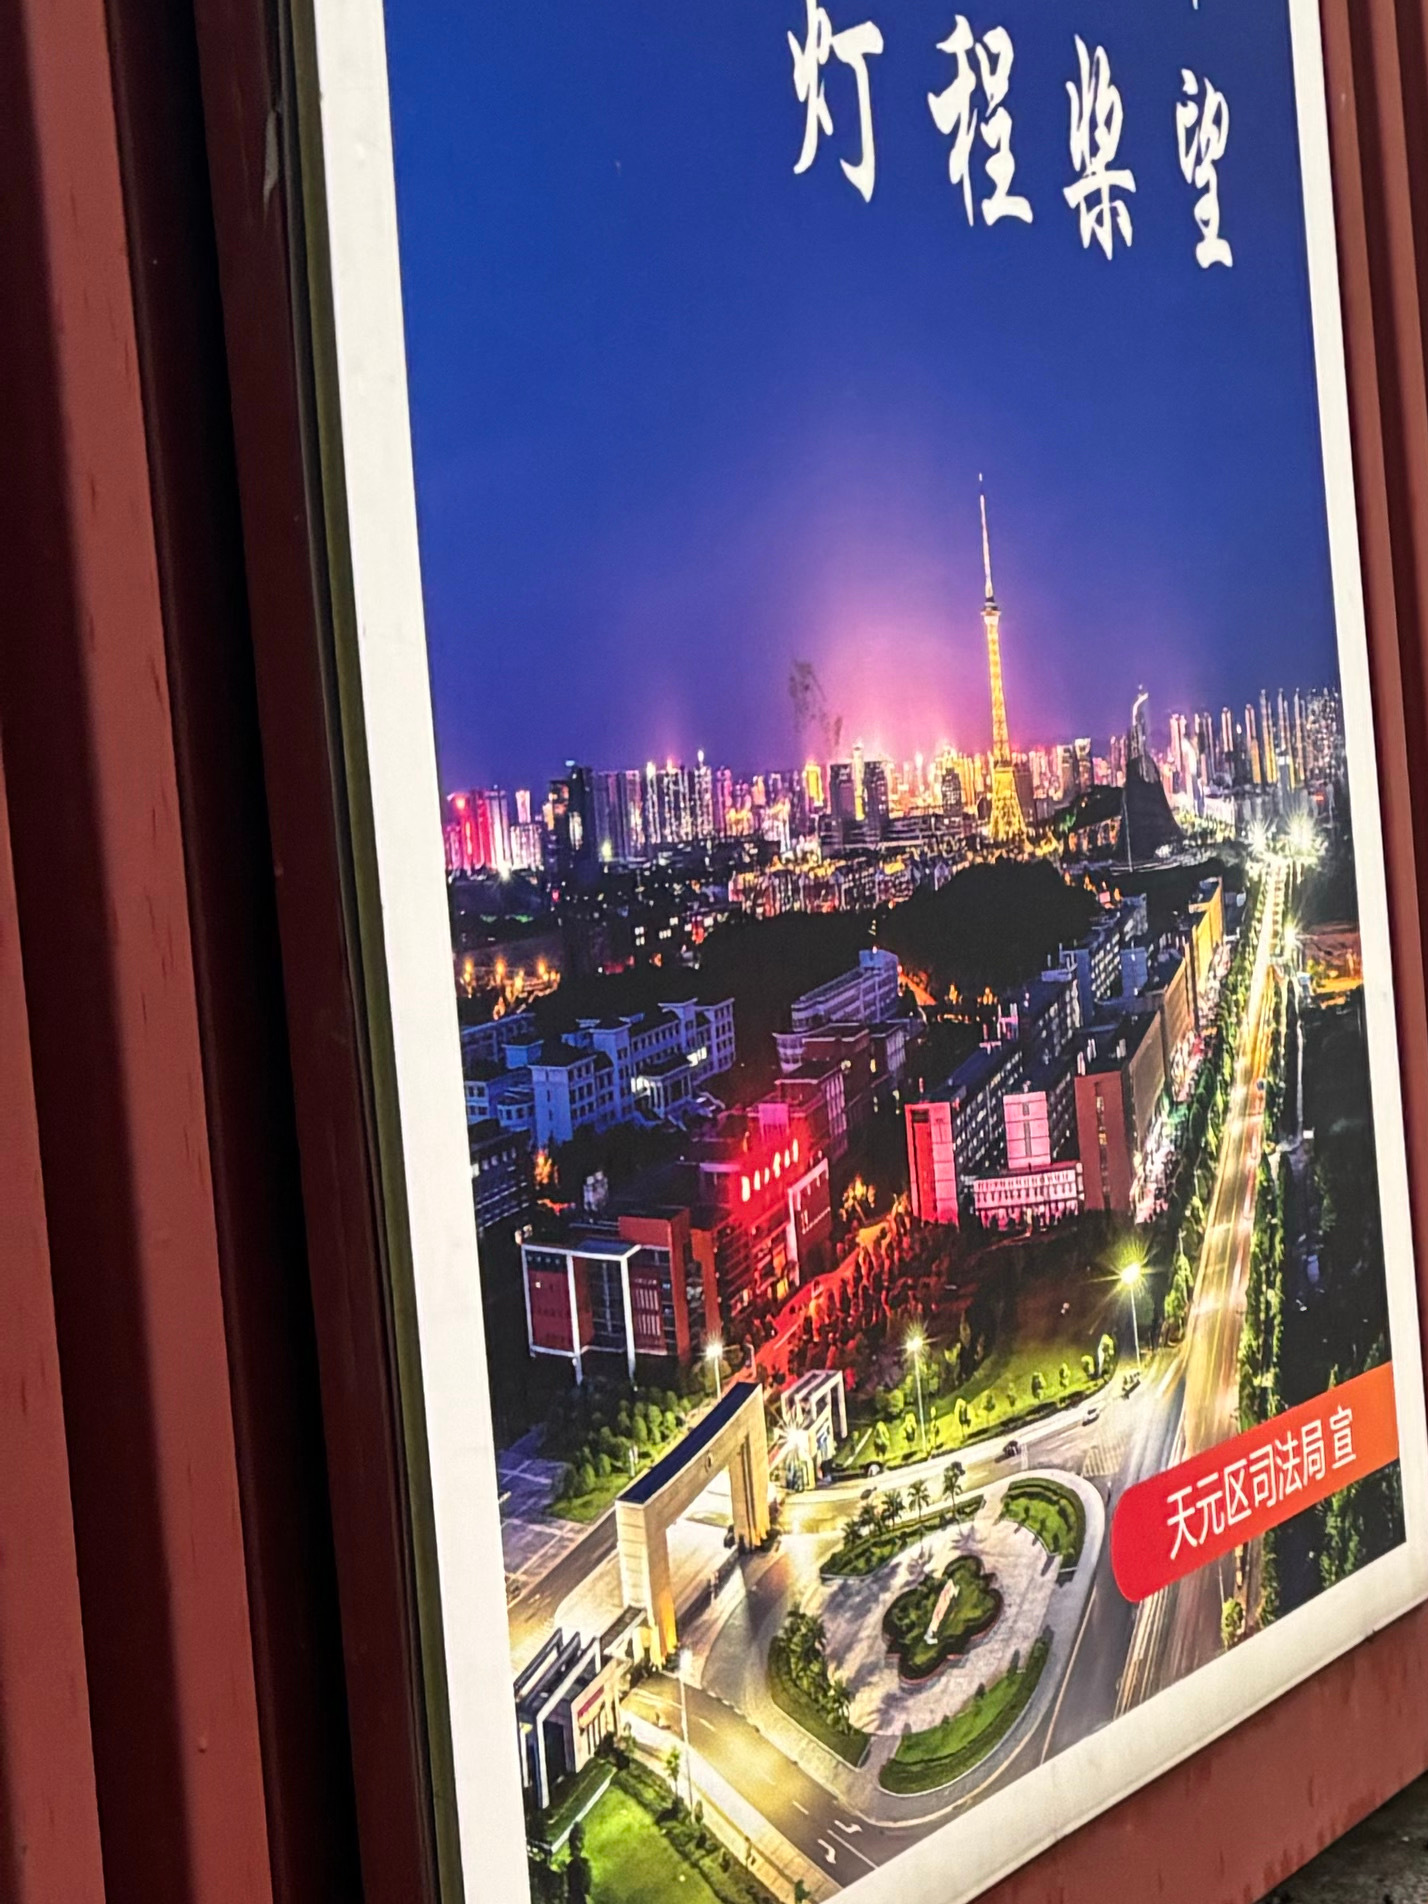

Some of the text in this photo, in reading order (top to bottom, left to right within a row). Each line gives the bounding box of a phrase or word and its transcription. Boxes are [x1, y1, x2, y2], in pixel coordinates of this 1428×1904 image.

[1166, 1405, 1357, 1561] 天元区司法局 宣
